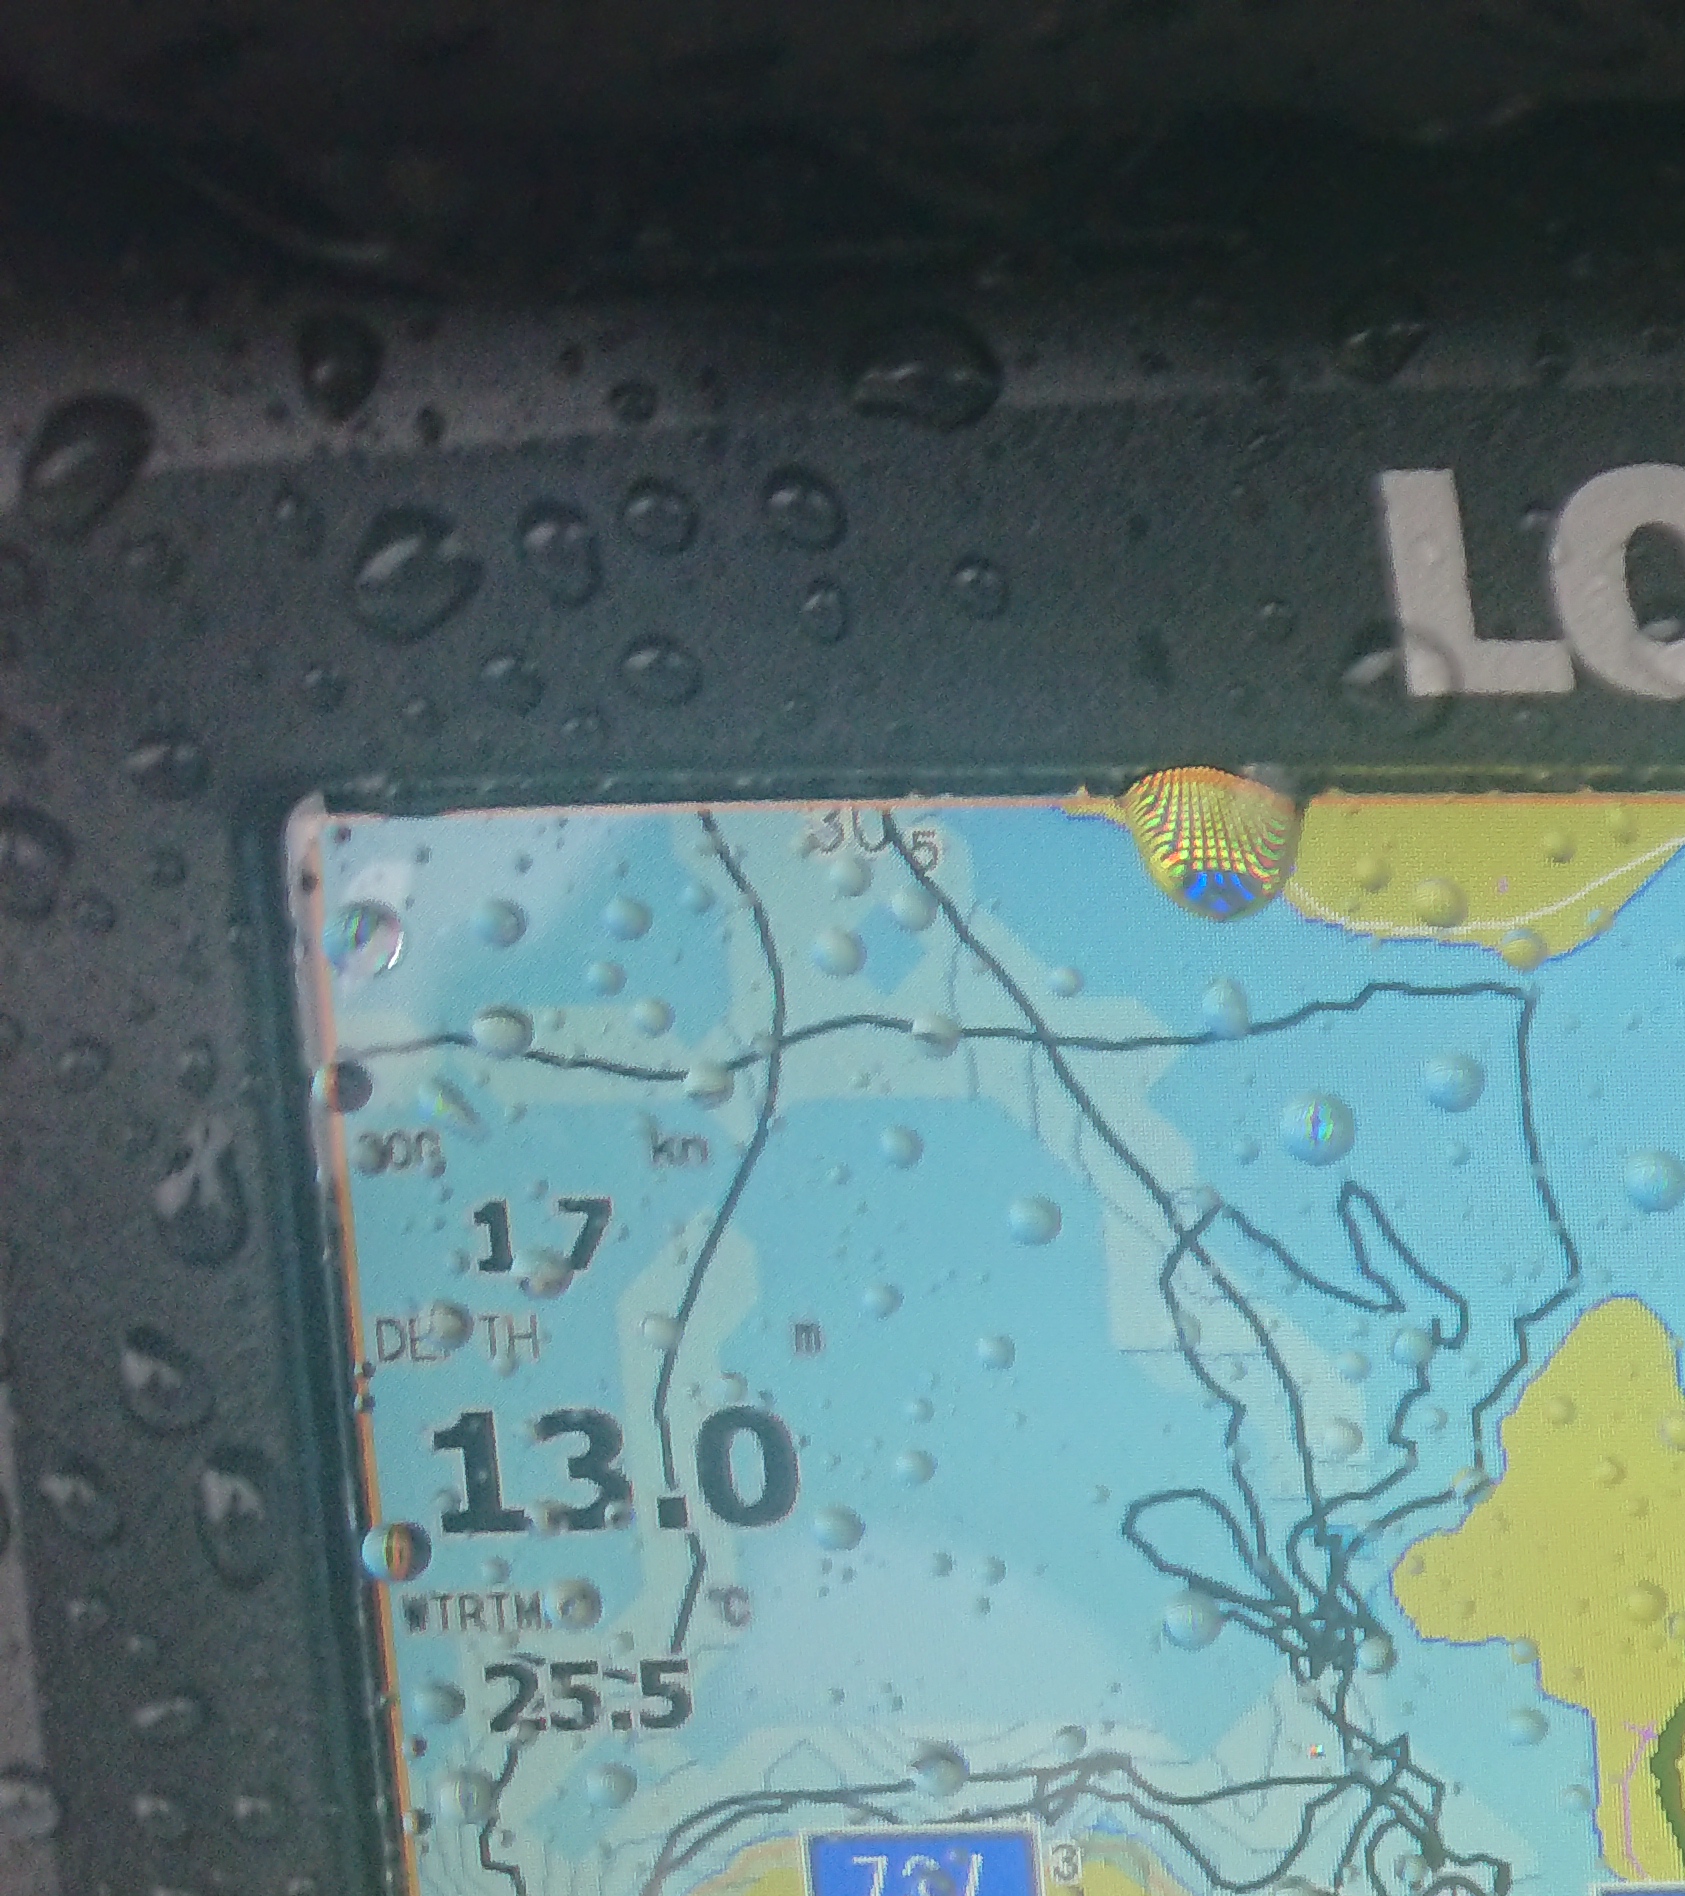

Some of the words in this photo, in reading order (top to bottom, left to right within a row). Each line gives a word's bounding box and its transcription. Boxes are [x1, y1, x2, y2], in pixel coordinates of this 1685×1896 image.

[376, 1314, 539, 1363] DETH
[433, 1406, 799, 1533] 13.0
[484, 1657, 693, 1733] 25.5
